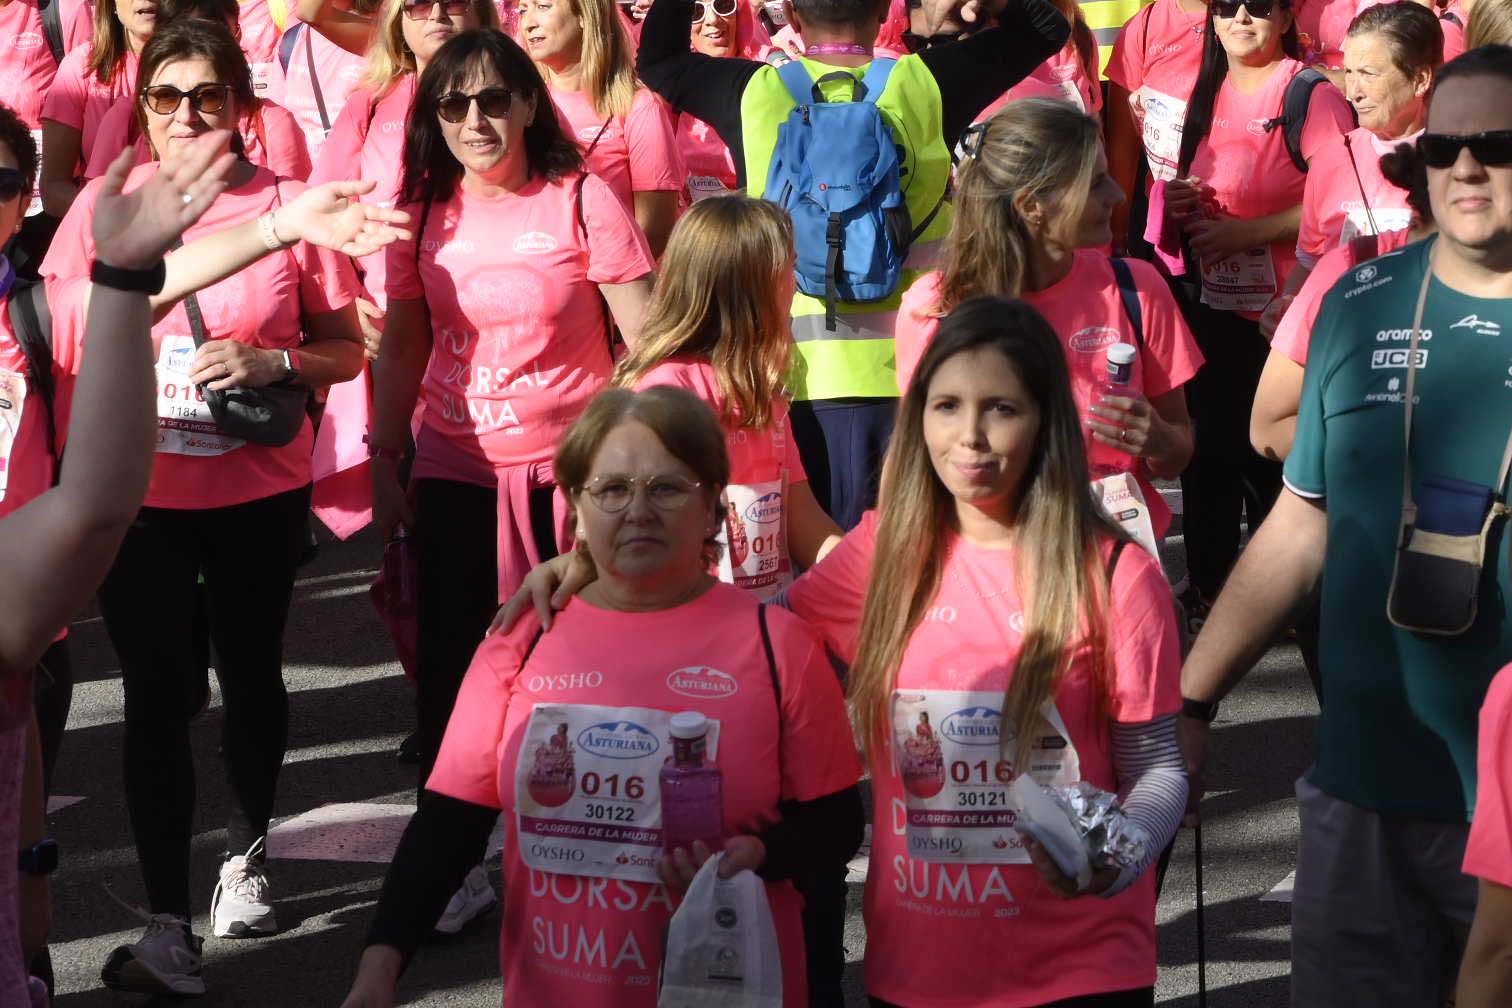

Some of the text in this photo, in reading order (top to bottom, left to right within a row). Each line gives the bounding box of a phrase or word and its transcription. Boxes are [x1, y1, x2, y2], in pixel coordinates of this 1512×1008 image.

[1344, 276, 1393, 299] crypto.com
[441, 329, 469, 354] TU
[445, 361, 549, 391] DORSAL
[442, 397, 520, 426] SUMA
[528, 671, 603, 693] OYSHO
[672, 675, 733, 692] ASTURIANA
[583, 732, 652, 752] ASTURIANA
[951, 759, 1013, 784] 016
[581, 772, 645, 800] 016
[958, 791, 1006, 807] 30121
[585, 803, 635, 823] 30122
[912, 813, 960, 824] CARRERA
[963, 814, 978, 824] DE
[980, 814, 994, 824] LA
[535, 822, 658, 843] CARRERA DE LA MUJER
[531, 843, 585, 863] OYSHO
[911, 835, 962, 854] OYSHO
[893, 854, 1015, 904] SUMA
[532, 915, 646, 970] SUMA
